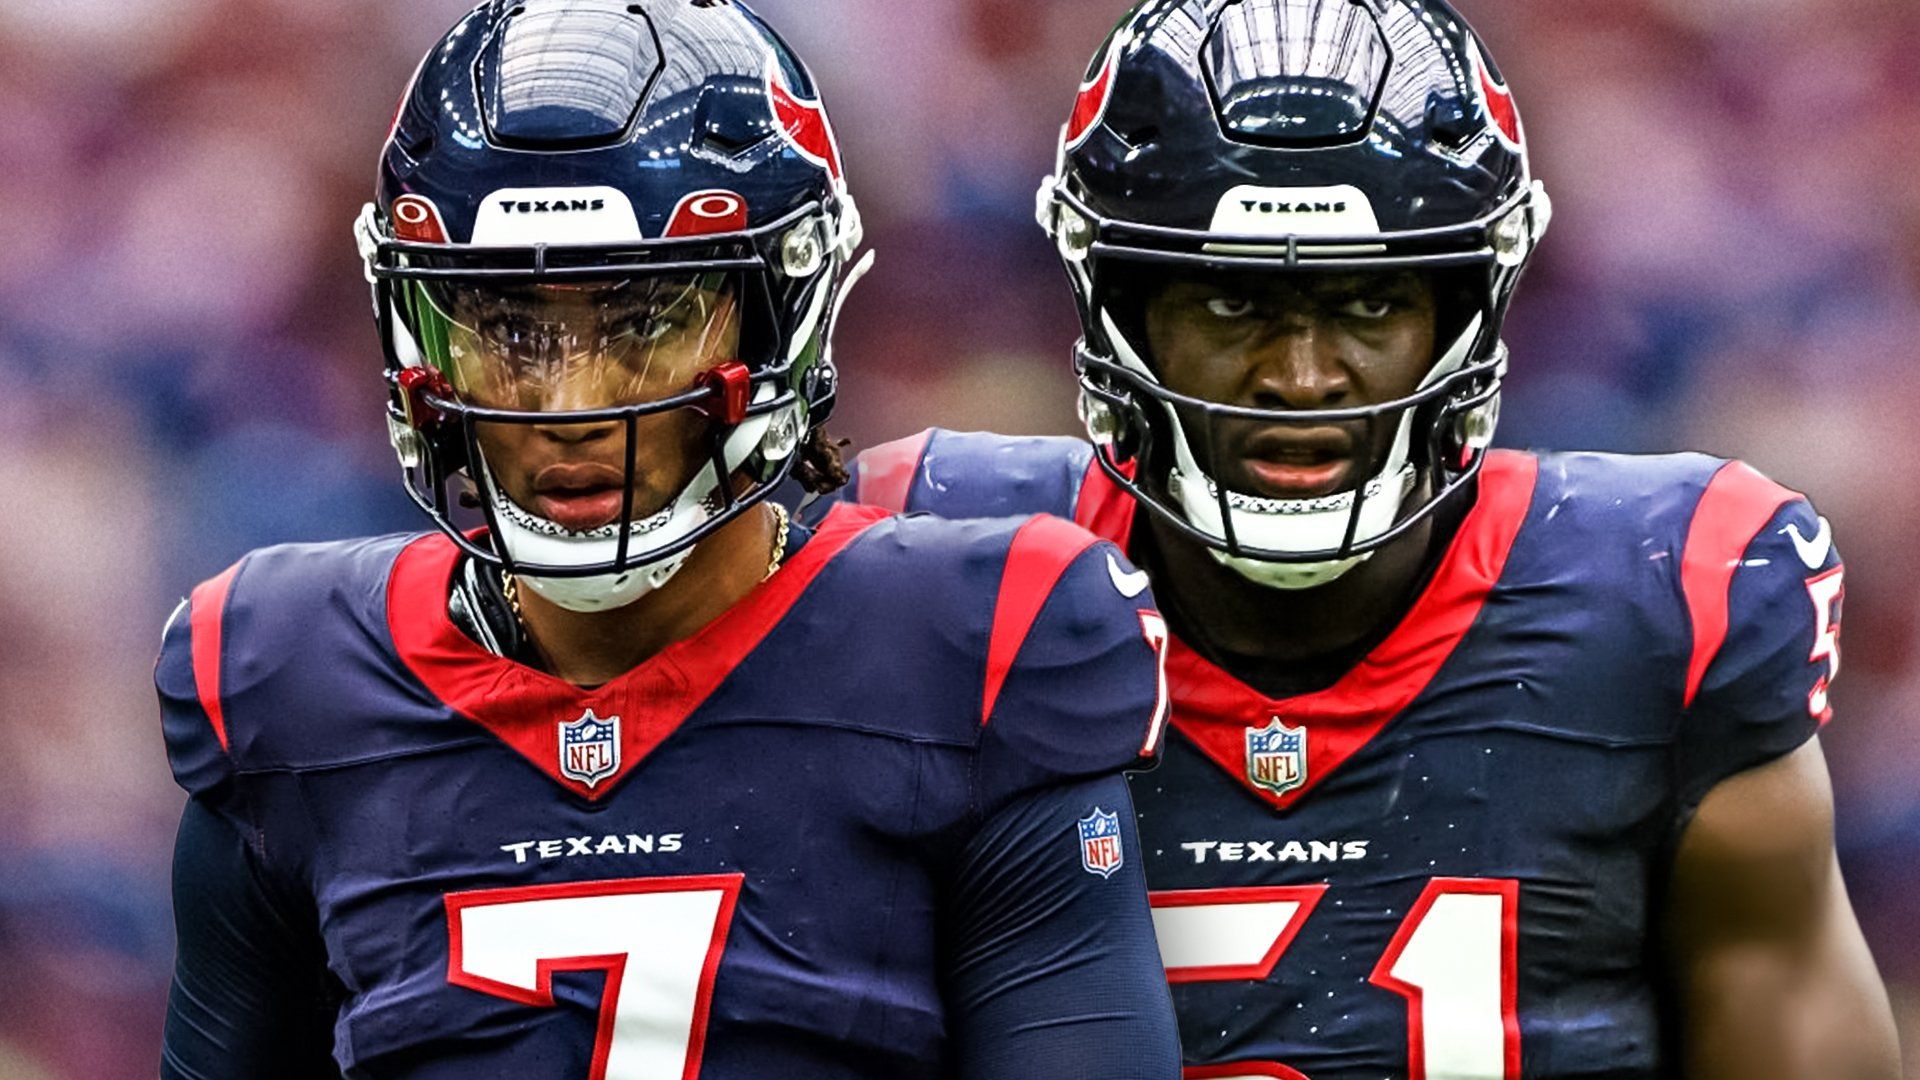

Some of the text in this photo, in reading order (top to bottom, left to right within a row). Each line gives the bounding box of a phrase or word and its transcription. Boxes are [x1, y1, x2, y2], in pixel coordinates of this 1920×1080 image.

[498, 198, 605, 213] TEXANS
[1240, 200, 1347, 213] TEXANS
[1137, 607, 1171, 757] 7
[569, 744, 611, 773] NFL
[1256, 754, 1298, 783] NFL
[500, 833, 684, 864] TEXANS
[1087, 838, 1120, 867] NFL
[1181, 839, 1370, 863] TEXANS
[444, 872, 745, 1080] 7
